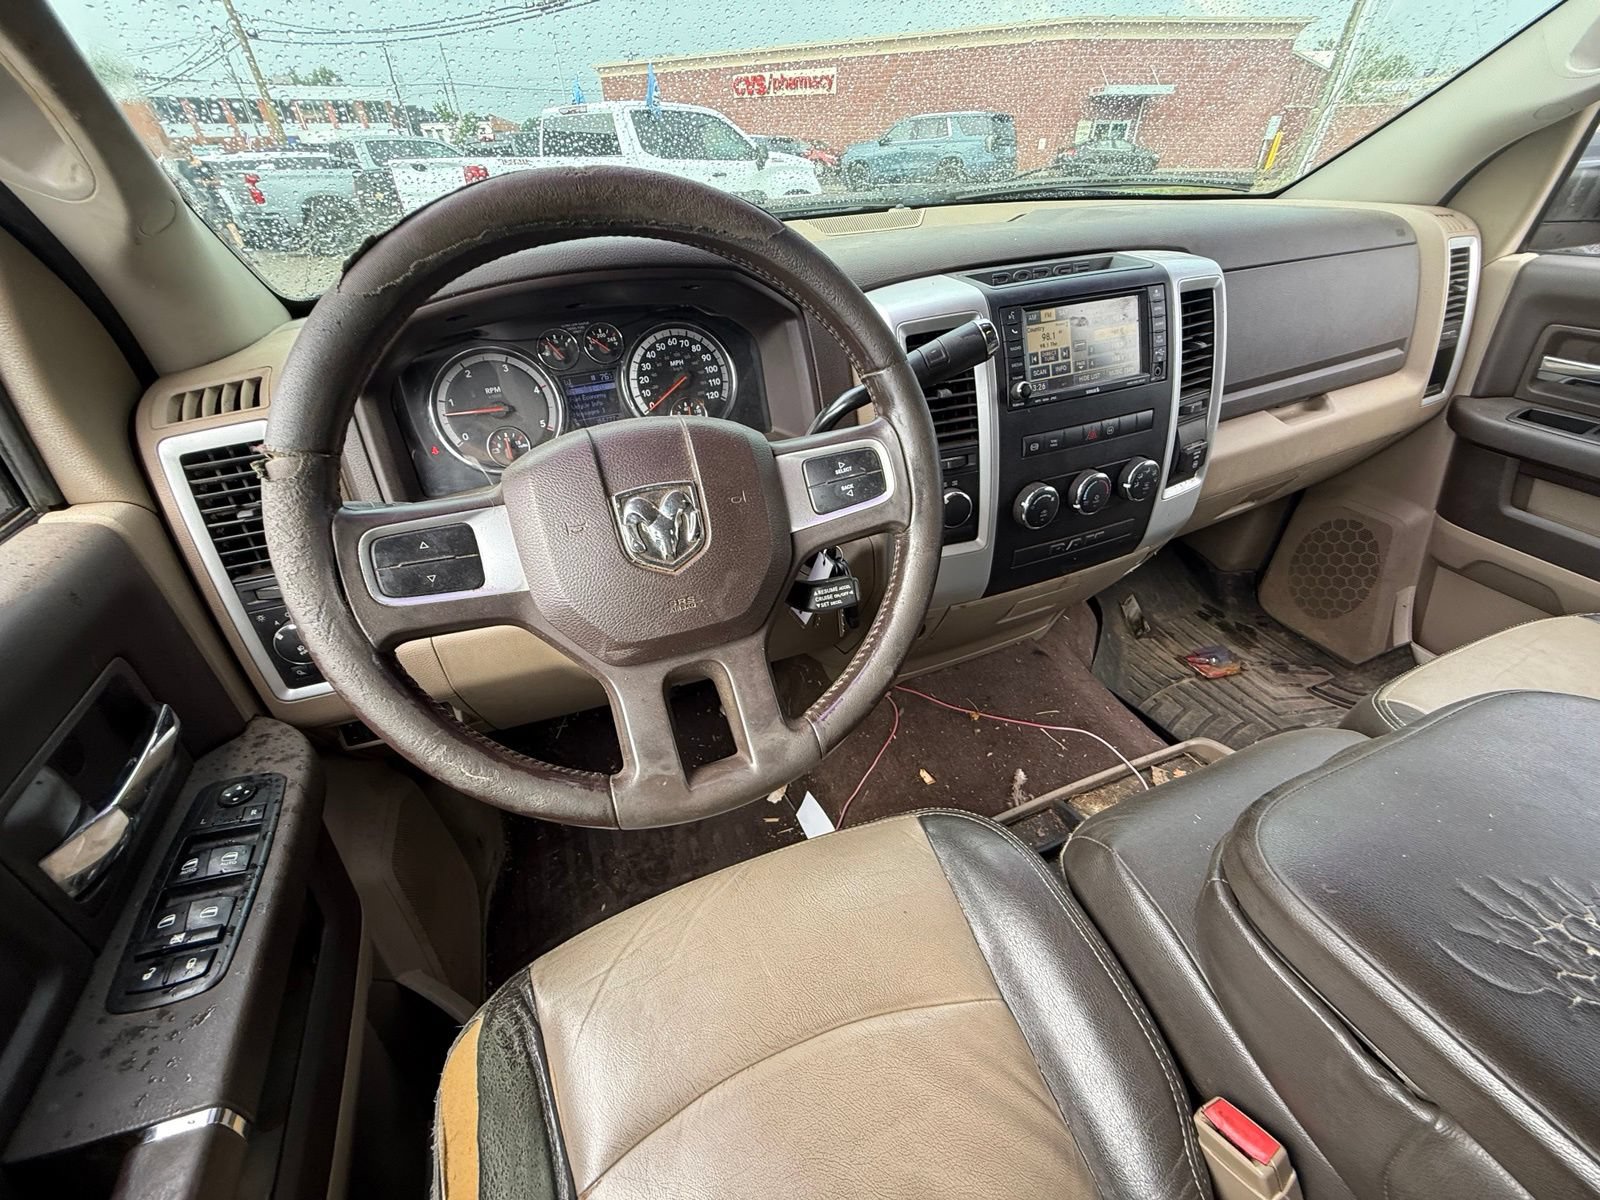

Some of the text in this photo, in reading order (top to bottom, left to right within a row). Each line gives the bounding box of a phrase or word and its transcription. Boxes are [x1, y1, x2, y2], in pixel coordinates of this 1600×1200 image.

[992, 261, 1090, 285] DODGE
[1042, 332, 1056, 341] 98.1
[656, 342, 665, 351] 50
[691, 344, 701, 352] 80
[502, 364, 509, 372] 3
[704, 365, 718, 373] 100
[465, 370, 472, 378] 2
[1033, 369, 1047, 377] SCAN
[639, 376, 649, 384] 20
[708, 378, 720, 386] 110
[1033, 383, 1046, 392] 3:26
[641, 389, 651, 397] 10
[706, 391, 719, 399] 120
[835, 466, 852, 475] SELECT
[818, 586, 838, 595] RESUME
[815, 594, 833, 602] CRUISE
